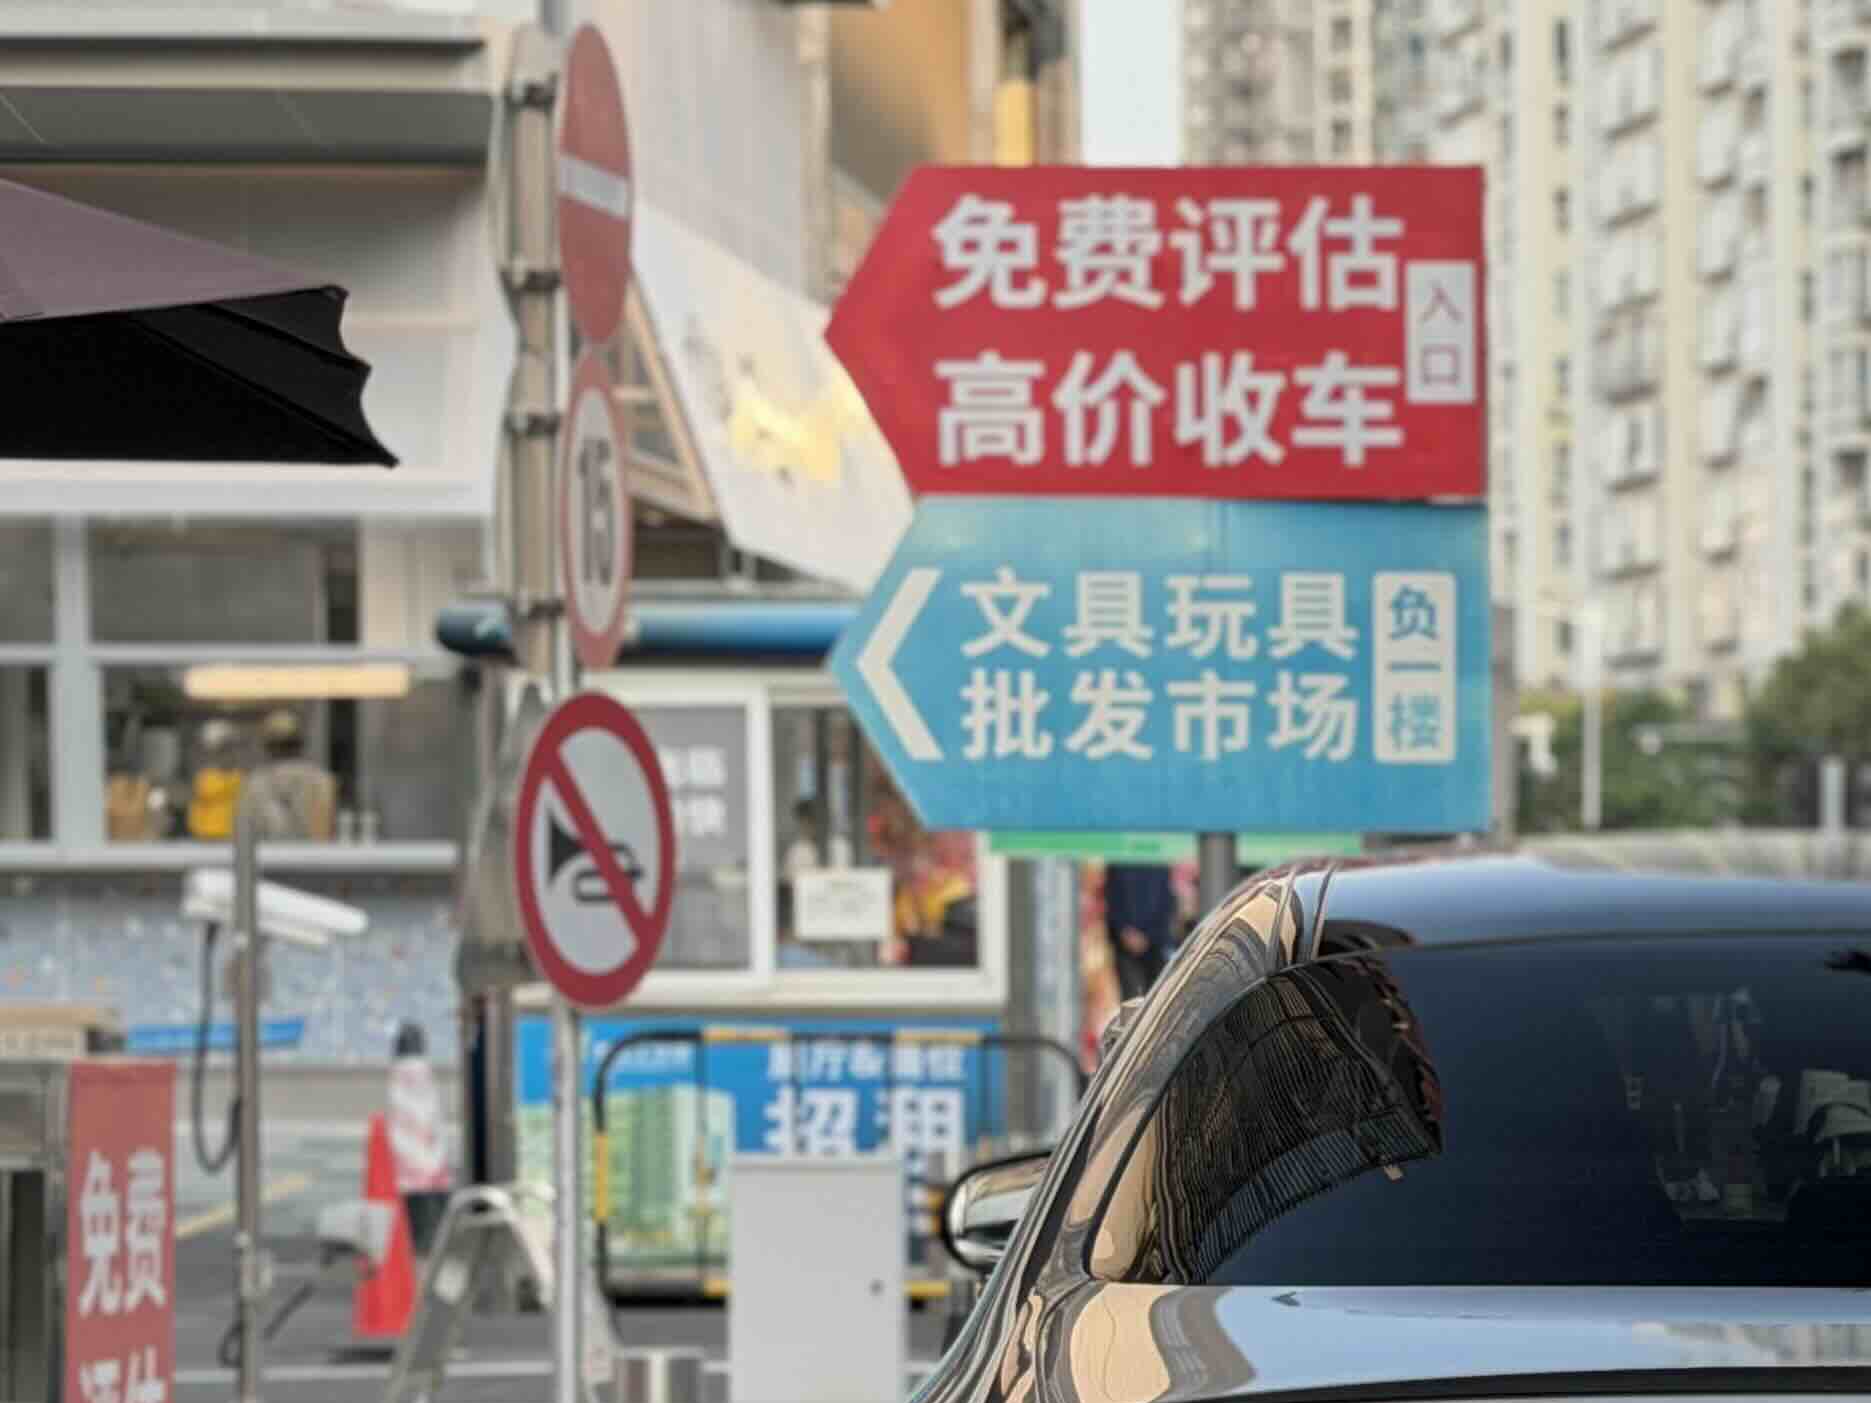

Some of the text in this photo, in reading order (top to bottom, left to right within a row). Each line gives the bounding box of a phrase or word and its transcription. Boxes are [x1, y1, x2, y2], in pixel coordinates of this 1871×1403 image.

[930, 192, 1405, 312] 免费评估
[1419, 280, 1463, 388] 入口
[932, 350, 1405, 468] 高价收车
[959, 568, 1360, 660] 文具玩具
[1388, 583, 1444, 752] 负一楼
[959, 669, 1360, 762] 批发市场
[77, 1147, 167, 1315] 免费
